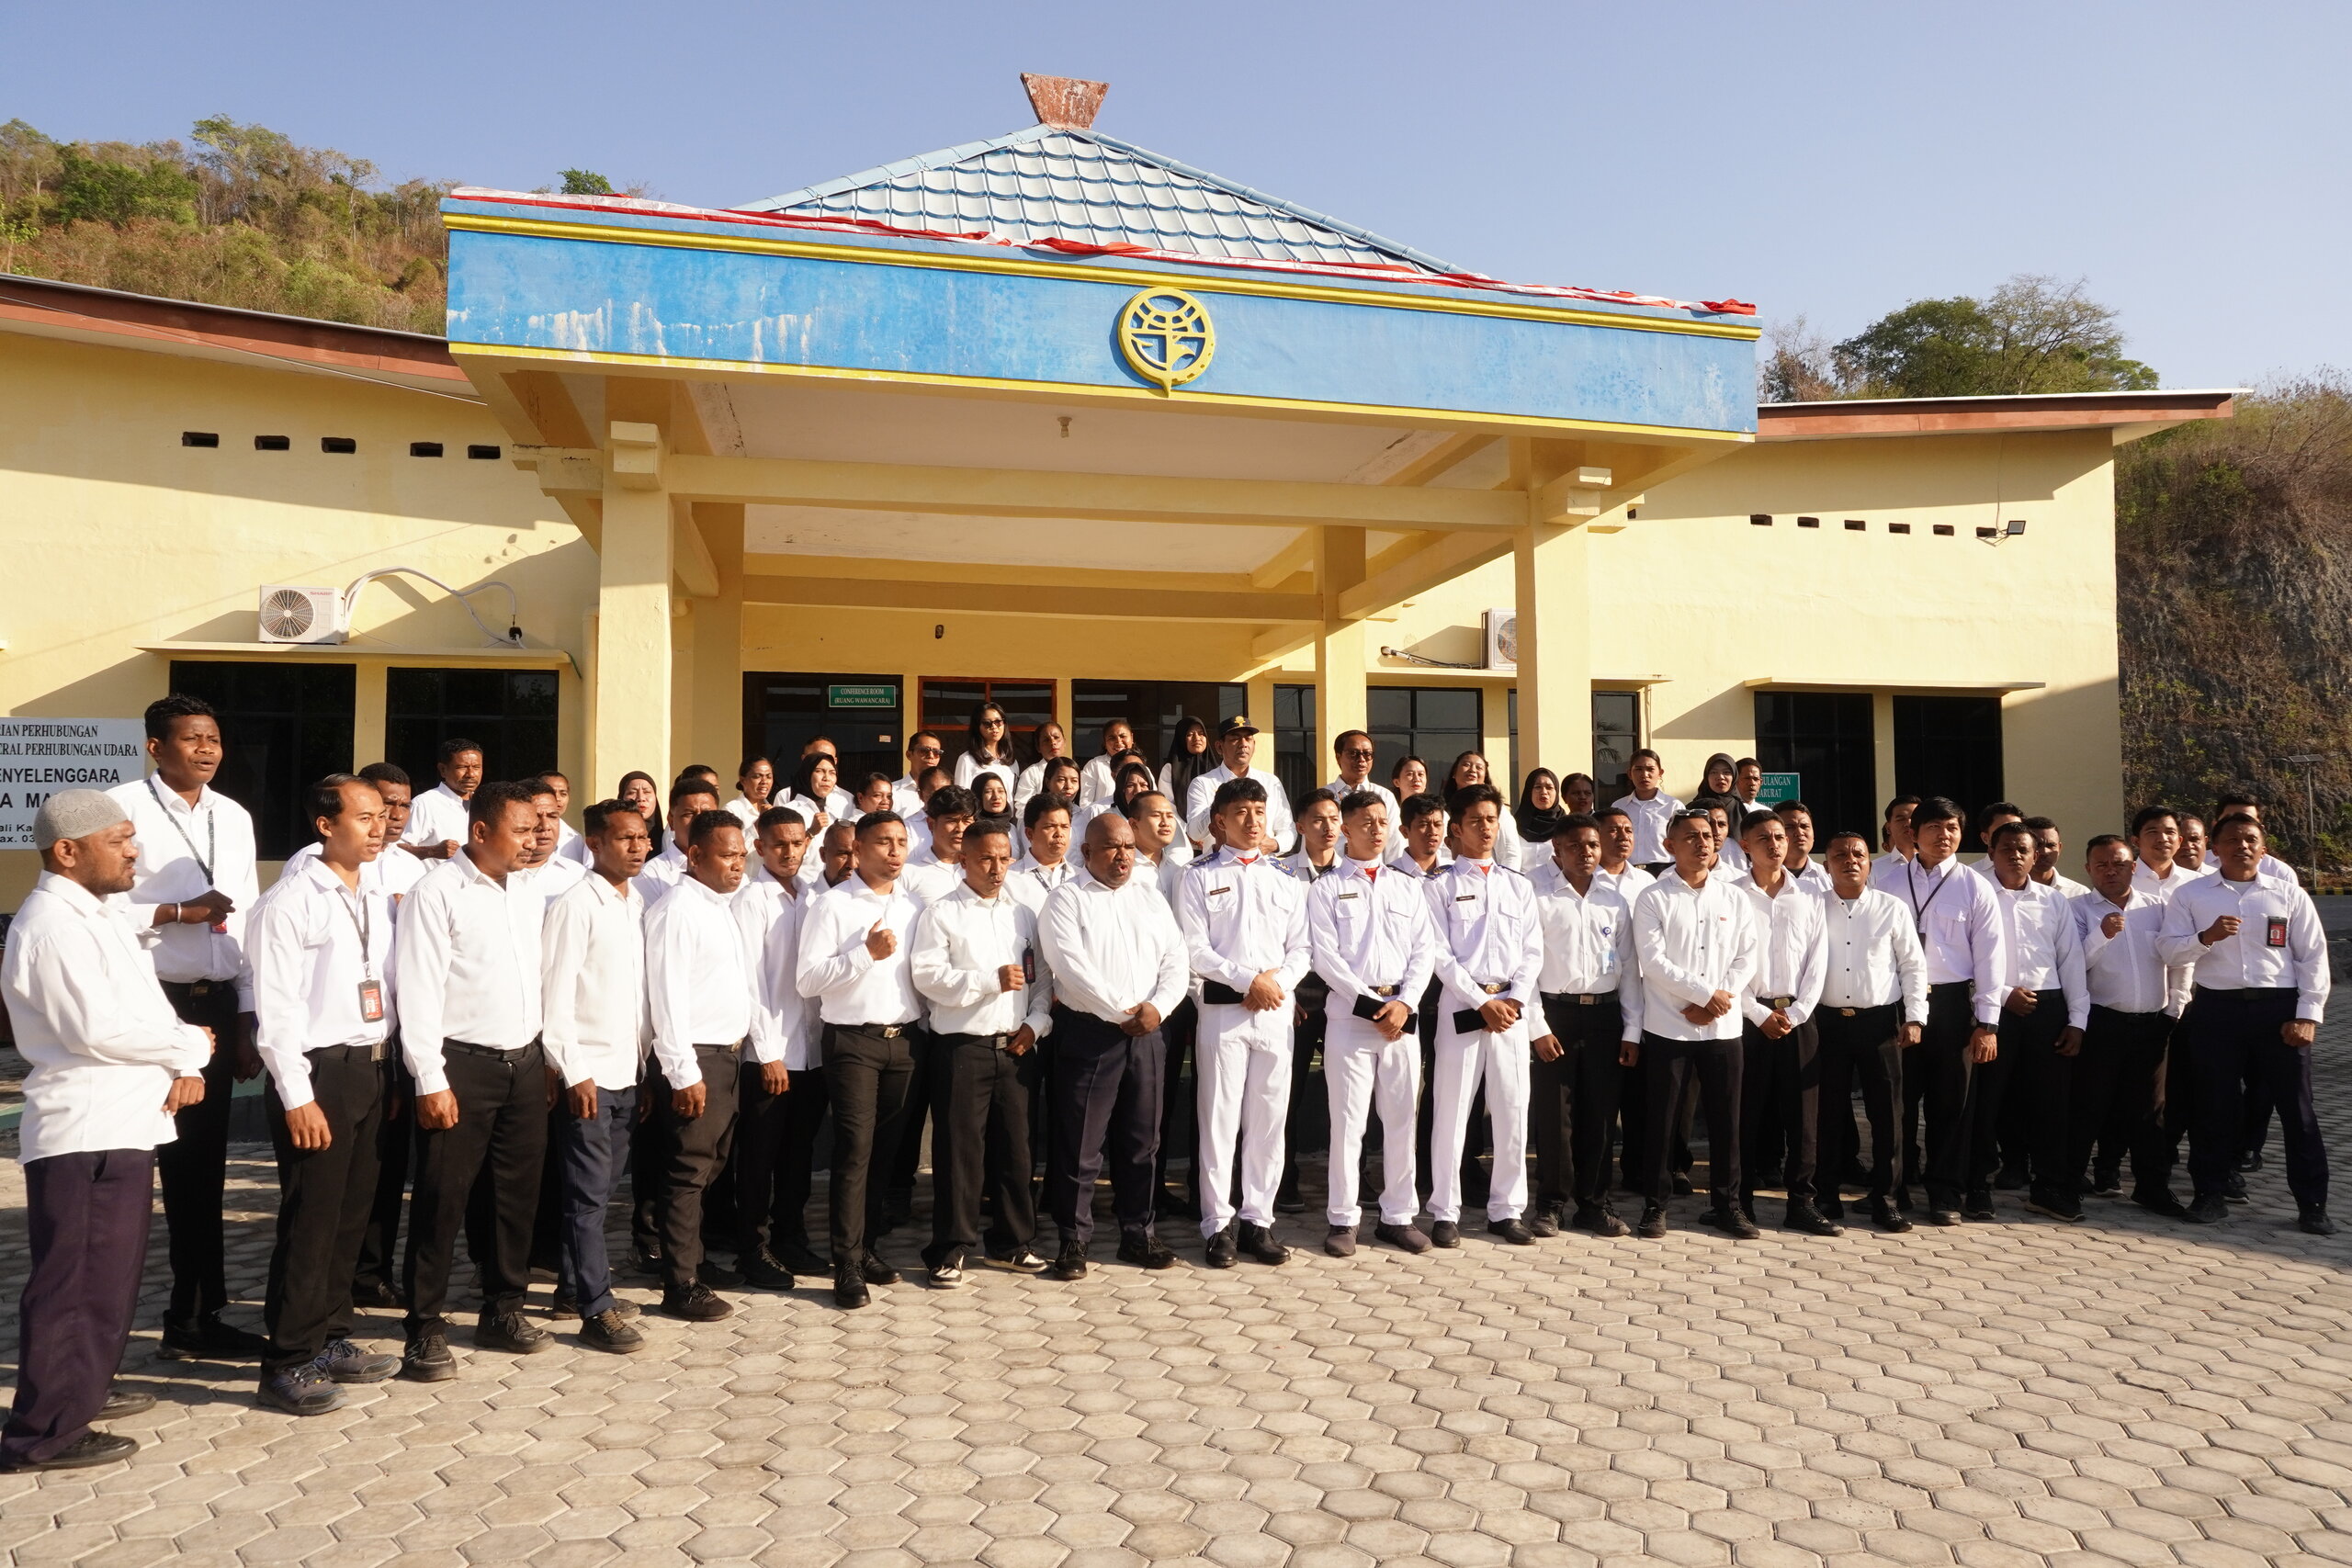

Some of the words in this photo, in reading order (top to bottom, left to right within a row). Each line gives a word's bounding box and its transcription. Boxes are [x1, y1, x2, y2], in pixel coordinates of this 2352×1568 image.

[21, 724, 98, 738] PERHUBUNGAN
[25, 742, 102, 757] PERHUBUNGAN
[104, 743, 138, 757] UDARA
[0, 768, 119, 784] NYELENGGARA
